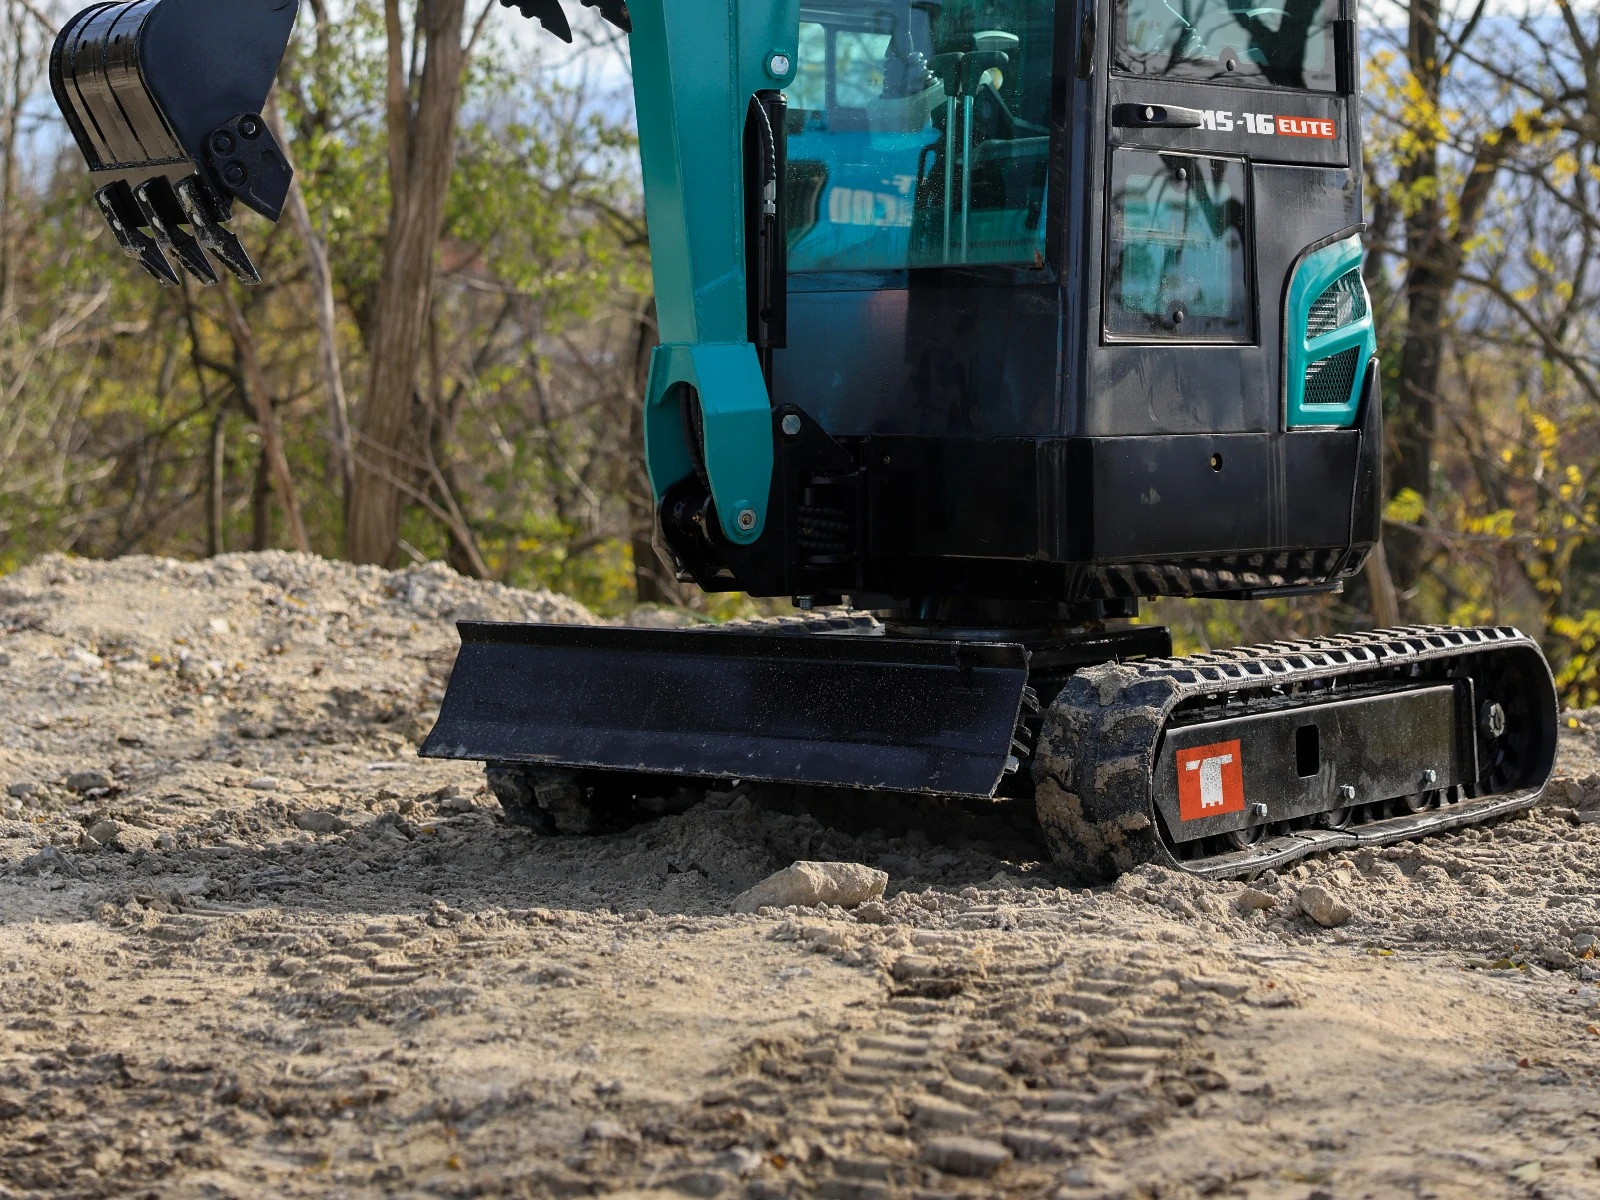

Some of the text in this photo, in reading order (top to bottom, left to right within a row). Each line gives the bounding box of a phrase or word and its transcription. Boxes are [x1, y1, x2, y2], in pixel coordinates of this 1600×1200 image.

[1197, 109, 1333, 136] MS-16 ELITE
[1185, 753, 1233, 809] T
